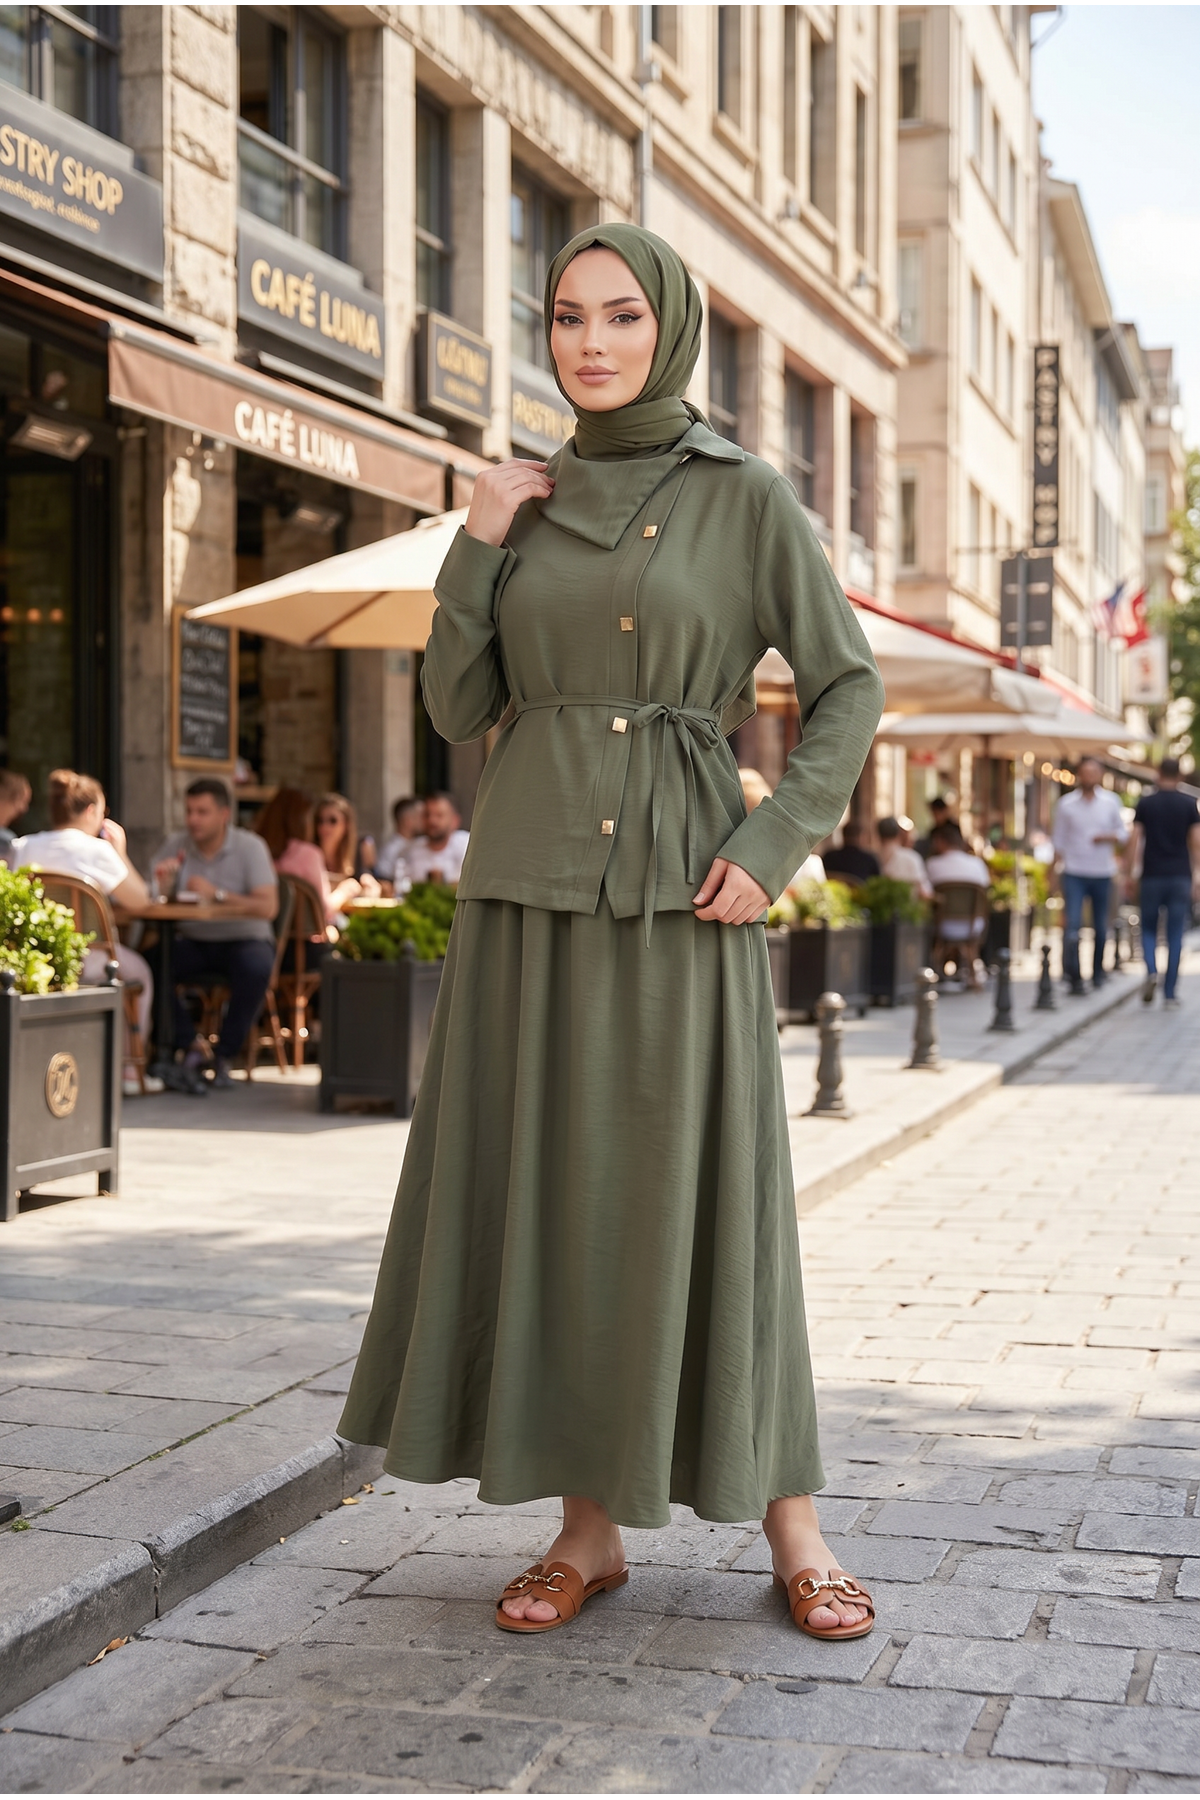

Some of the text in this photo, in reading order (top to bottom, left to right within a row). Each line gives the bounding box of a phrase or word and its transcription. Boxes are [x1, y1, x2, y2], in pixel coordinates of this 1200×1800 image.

[0, 124, 59, 186] STRY
[61, 156, 123, 216] SHOP
[250, 258, 382, 359] CAFÉ LUNA
[234, 400, 361, 480] CAFÉ LUNA
